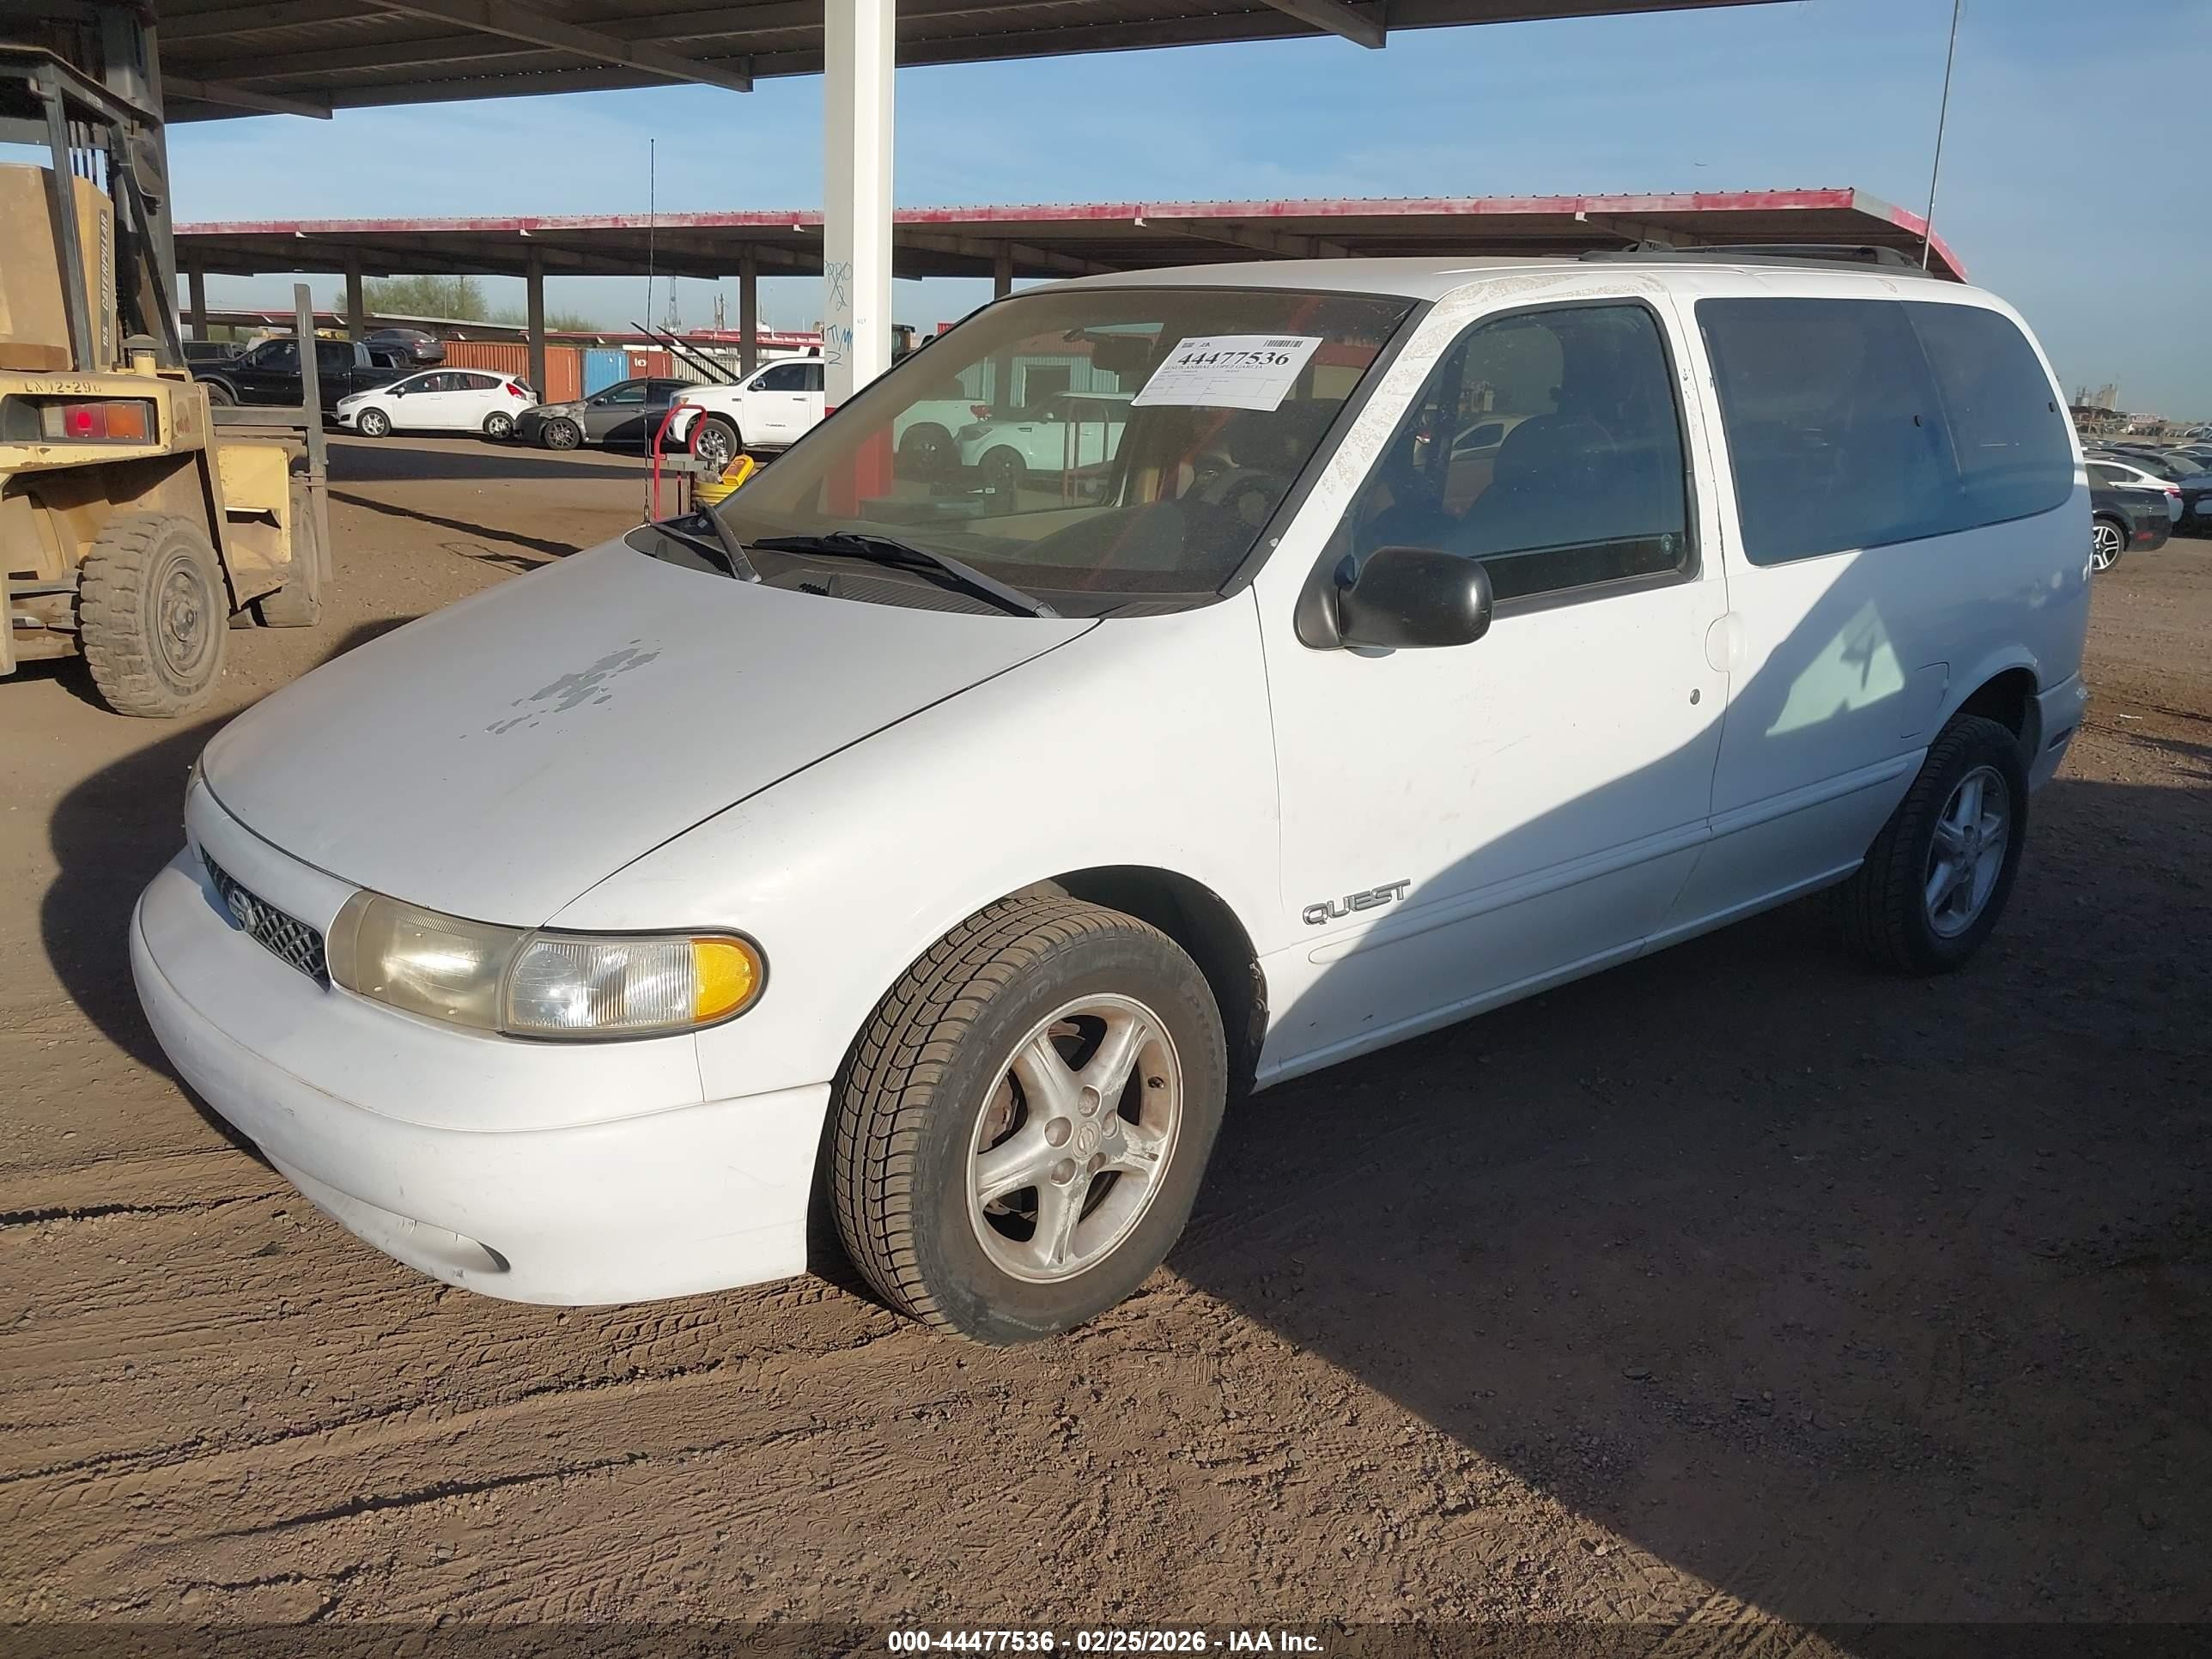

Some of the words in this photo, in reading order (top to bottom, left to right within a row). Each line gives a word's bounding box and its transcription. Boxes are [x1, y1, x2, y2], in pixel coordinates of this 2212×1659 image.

[100, 214, 109, 312] CATERPILLAR
[1177, 351, 1291, 366] 44477536
[1302, 878, 1411, 926] QUEST
